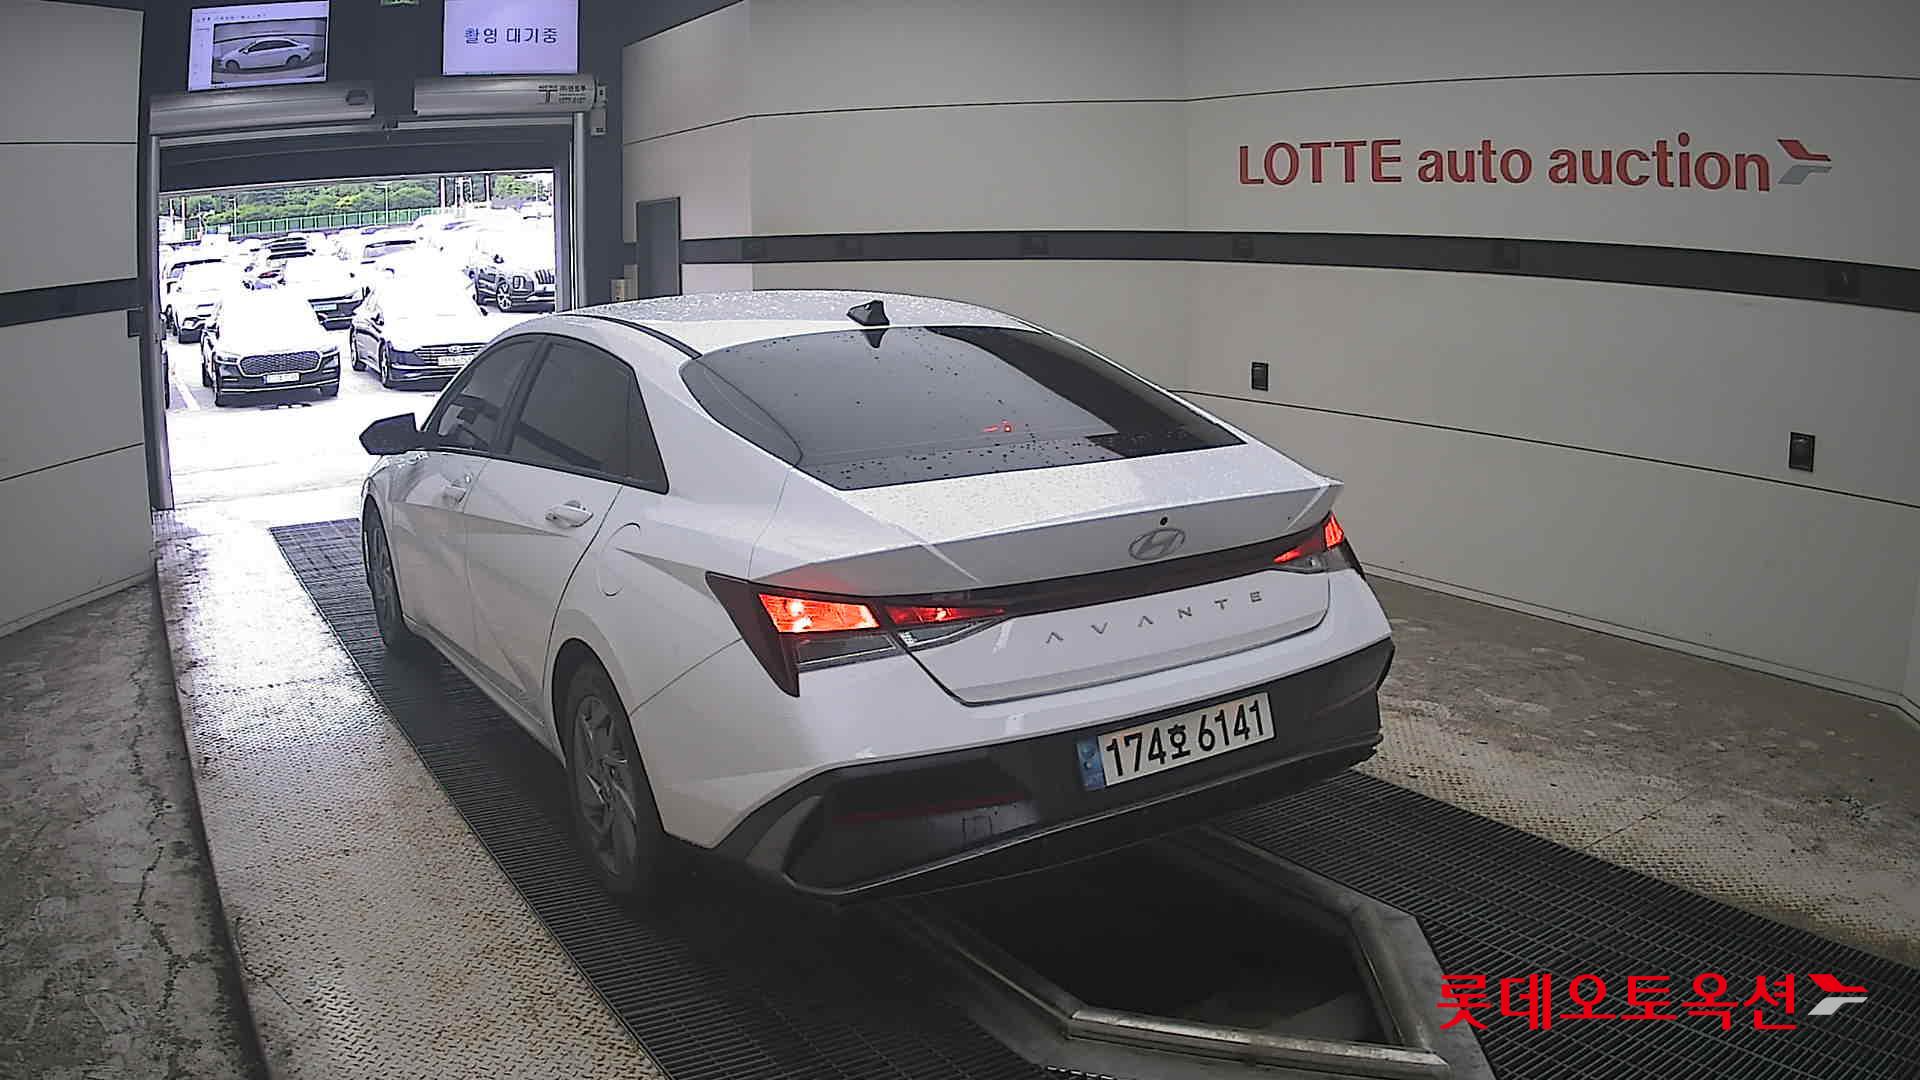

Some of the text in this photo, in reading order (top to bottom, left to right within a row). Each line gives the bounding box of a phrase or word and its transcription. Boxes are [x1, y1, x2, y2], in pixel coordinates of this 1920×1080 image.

[465, 27, 558, 44] 촬영 대기중
[1239, 131, 1771, 192] LOTTE auto auction
[1045, 590, 1263, 645] AVANTE
[1106, 699, 1265, 777] 174호 6141
